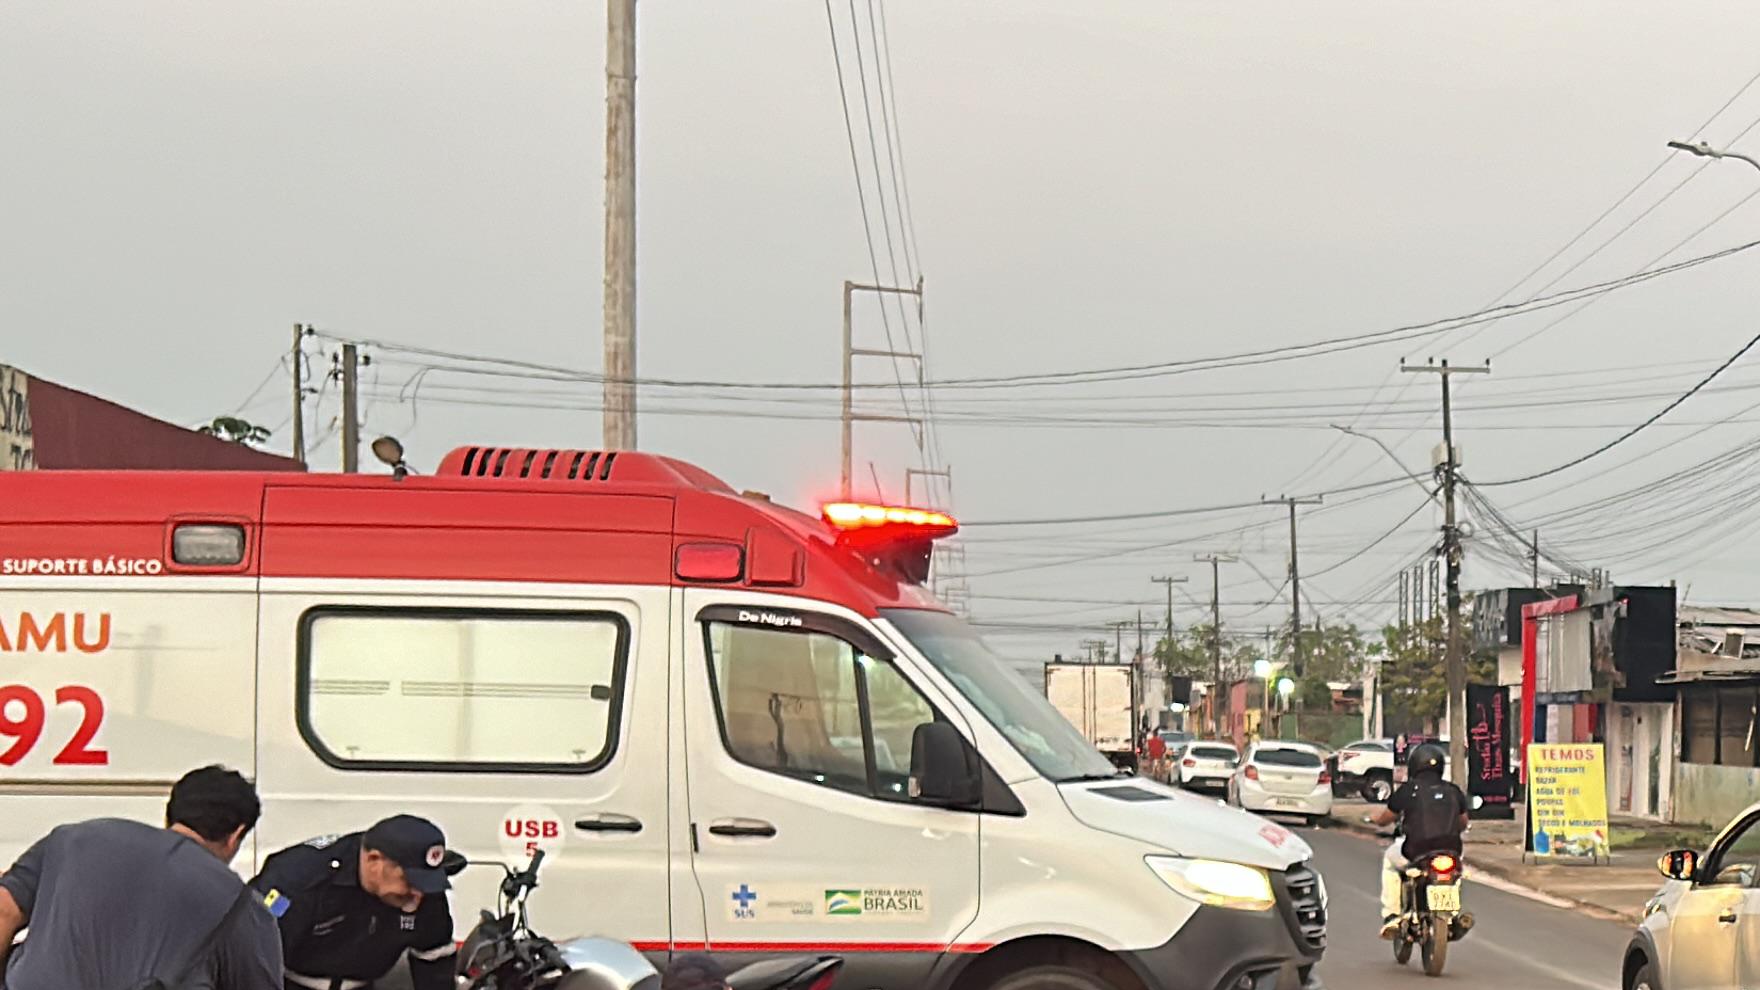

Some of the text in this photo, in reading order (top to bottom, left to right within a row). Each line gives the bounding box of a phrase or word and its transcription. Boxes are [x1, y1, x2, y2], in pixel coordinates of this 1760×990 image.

[3, 555, 162, 574] SUPORTE BÁSICO
[0, 684, 109, 767] 92
[1541, 749, 1595, 761] TEMOS
[505, 819, 559, 838] USB
[864, 898, 924, 911] BRASIL
[734, 908, 755, 918] SUS
